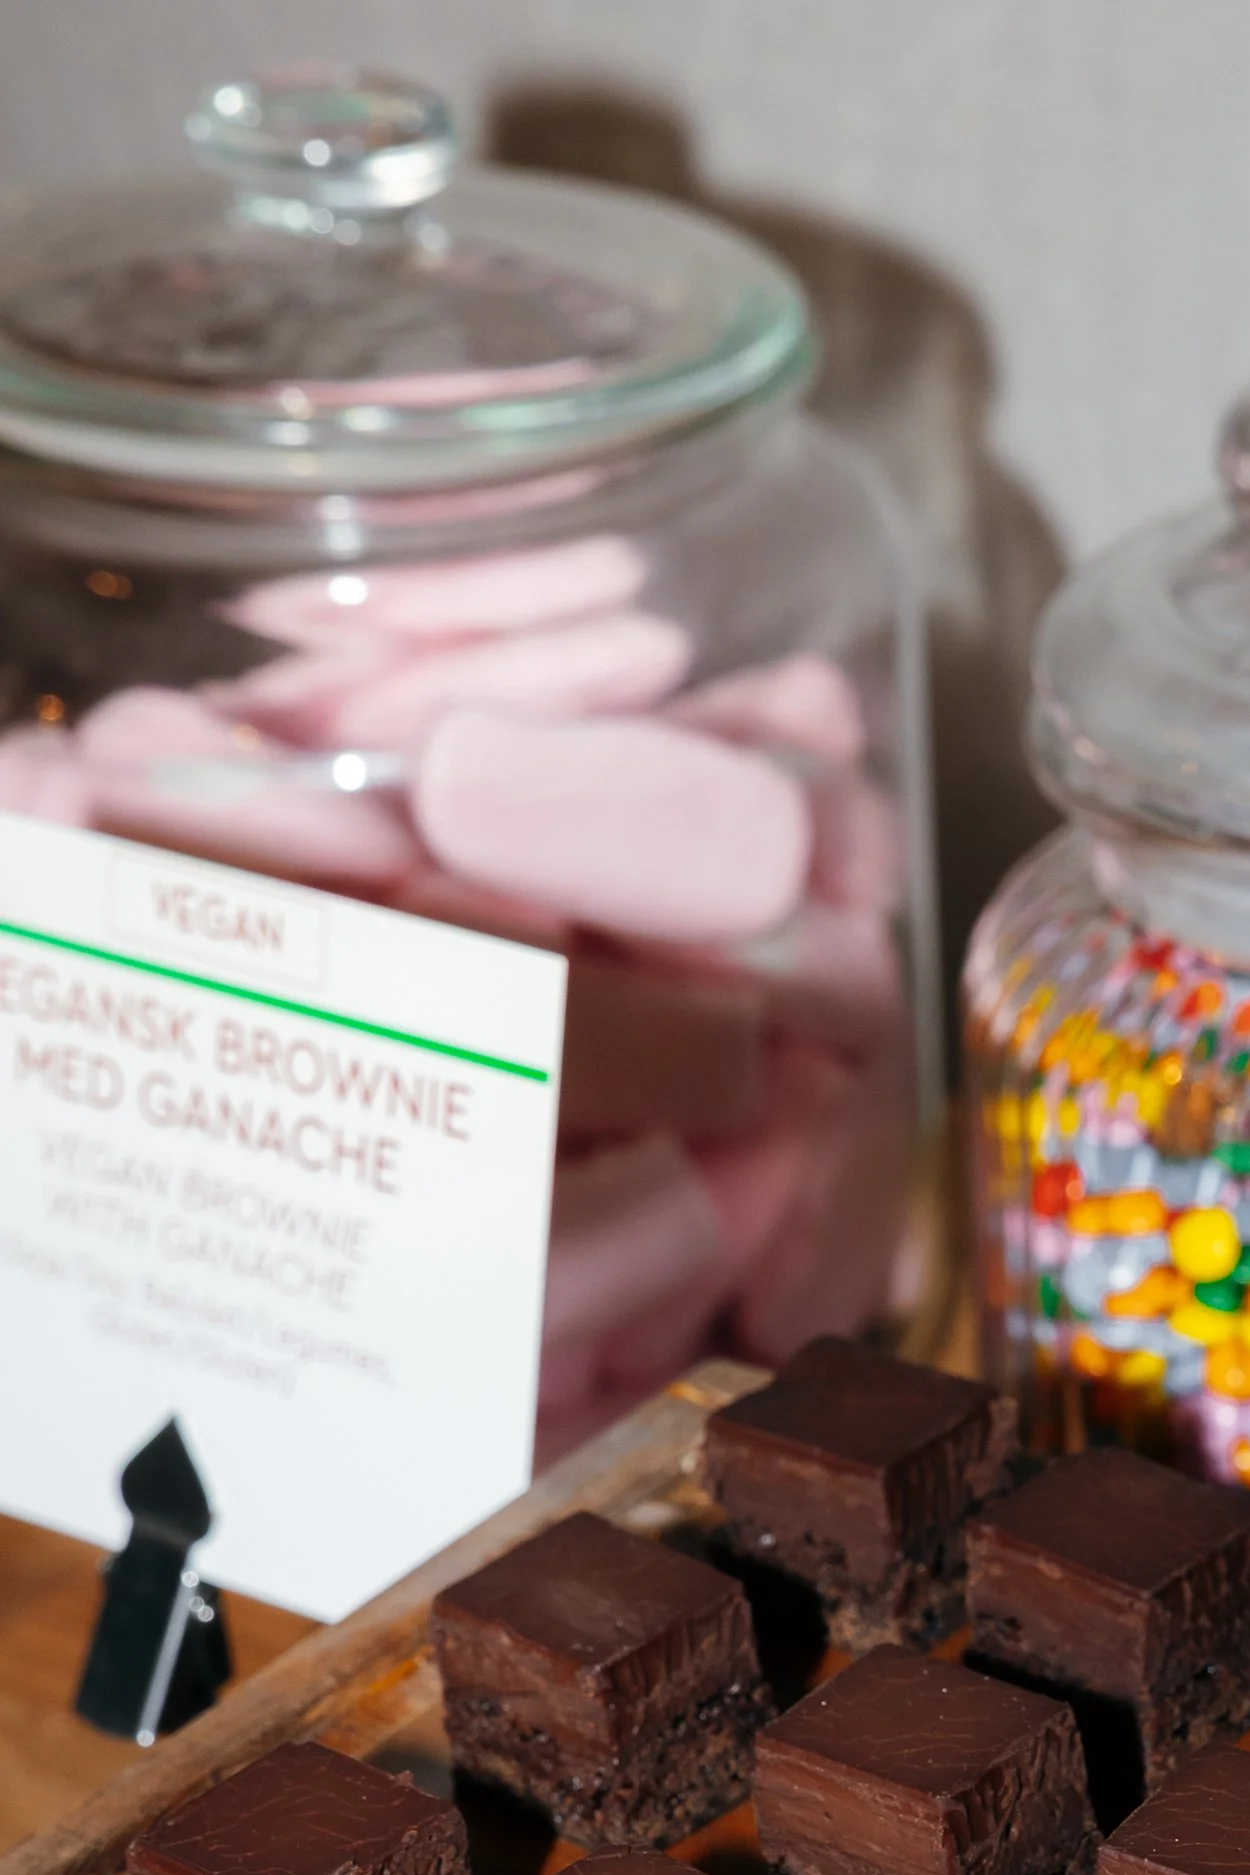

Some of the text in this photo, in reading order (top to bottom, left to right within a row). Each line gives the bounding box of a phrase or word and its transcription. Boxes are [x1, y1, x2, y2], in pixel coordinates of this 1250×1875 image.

[151, 880, 285, 951] VEGAN
[15, 1036, 402, 1196] MED GANACHE
[215, 1018, 474, 1142] BROWNIE
